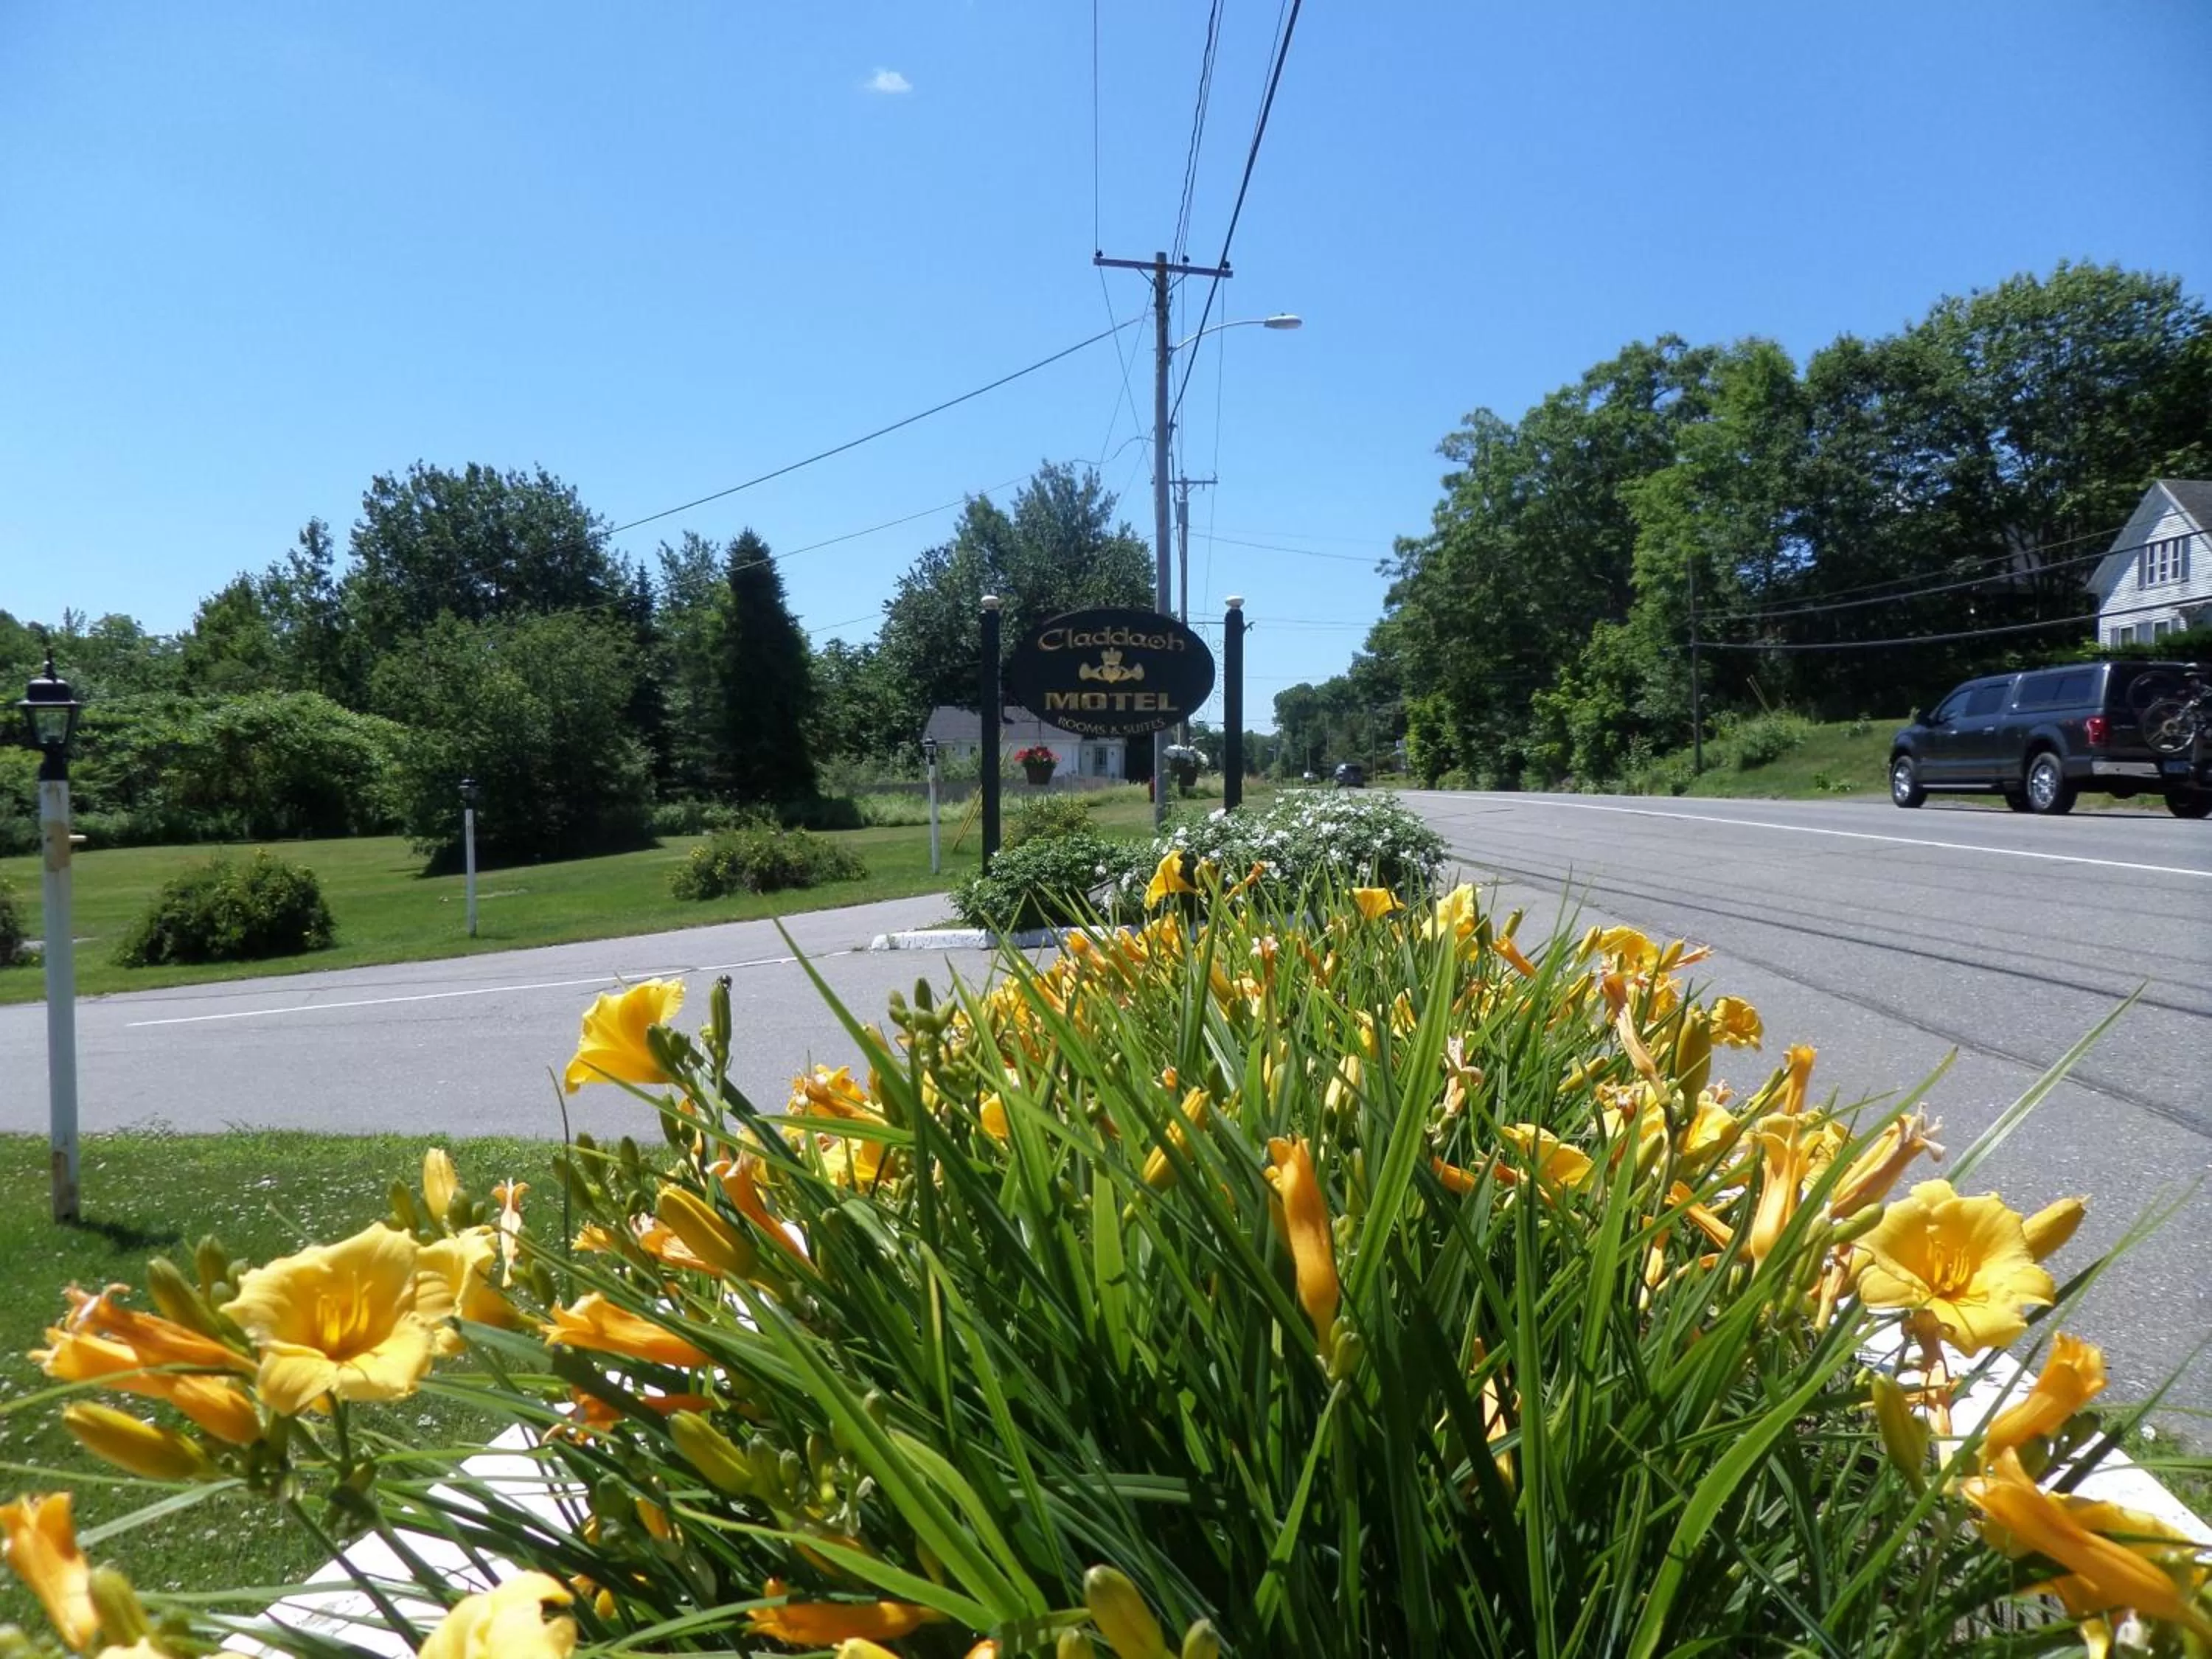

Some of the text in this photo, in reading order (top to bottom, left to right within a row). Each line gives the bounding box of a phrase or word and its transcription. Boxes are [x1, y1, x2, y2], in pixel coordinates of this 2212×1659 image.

[1037, 626, 1185, 651] Claddagh
[1044, 692, 1179, 712] MOTEL
[1057, 716, 1166, 735] ROOMS & SUITES
